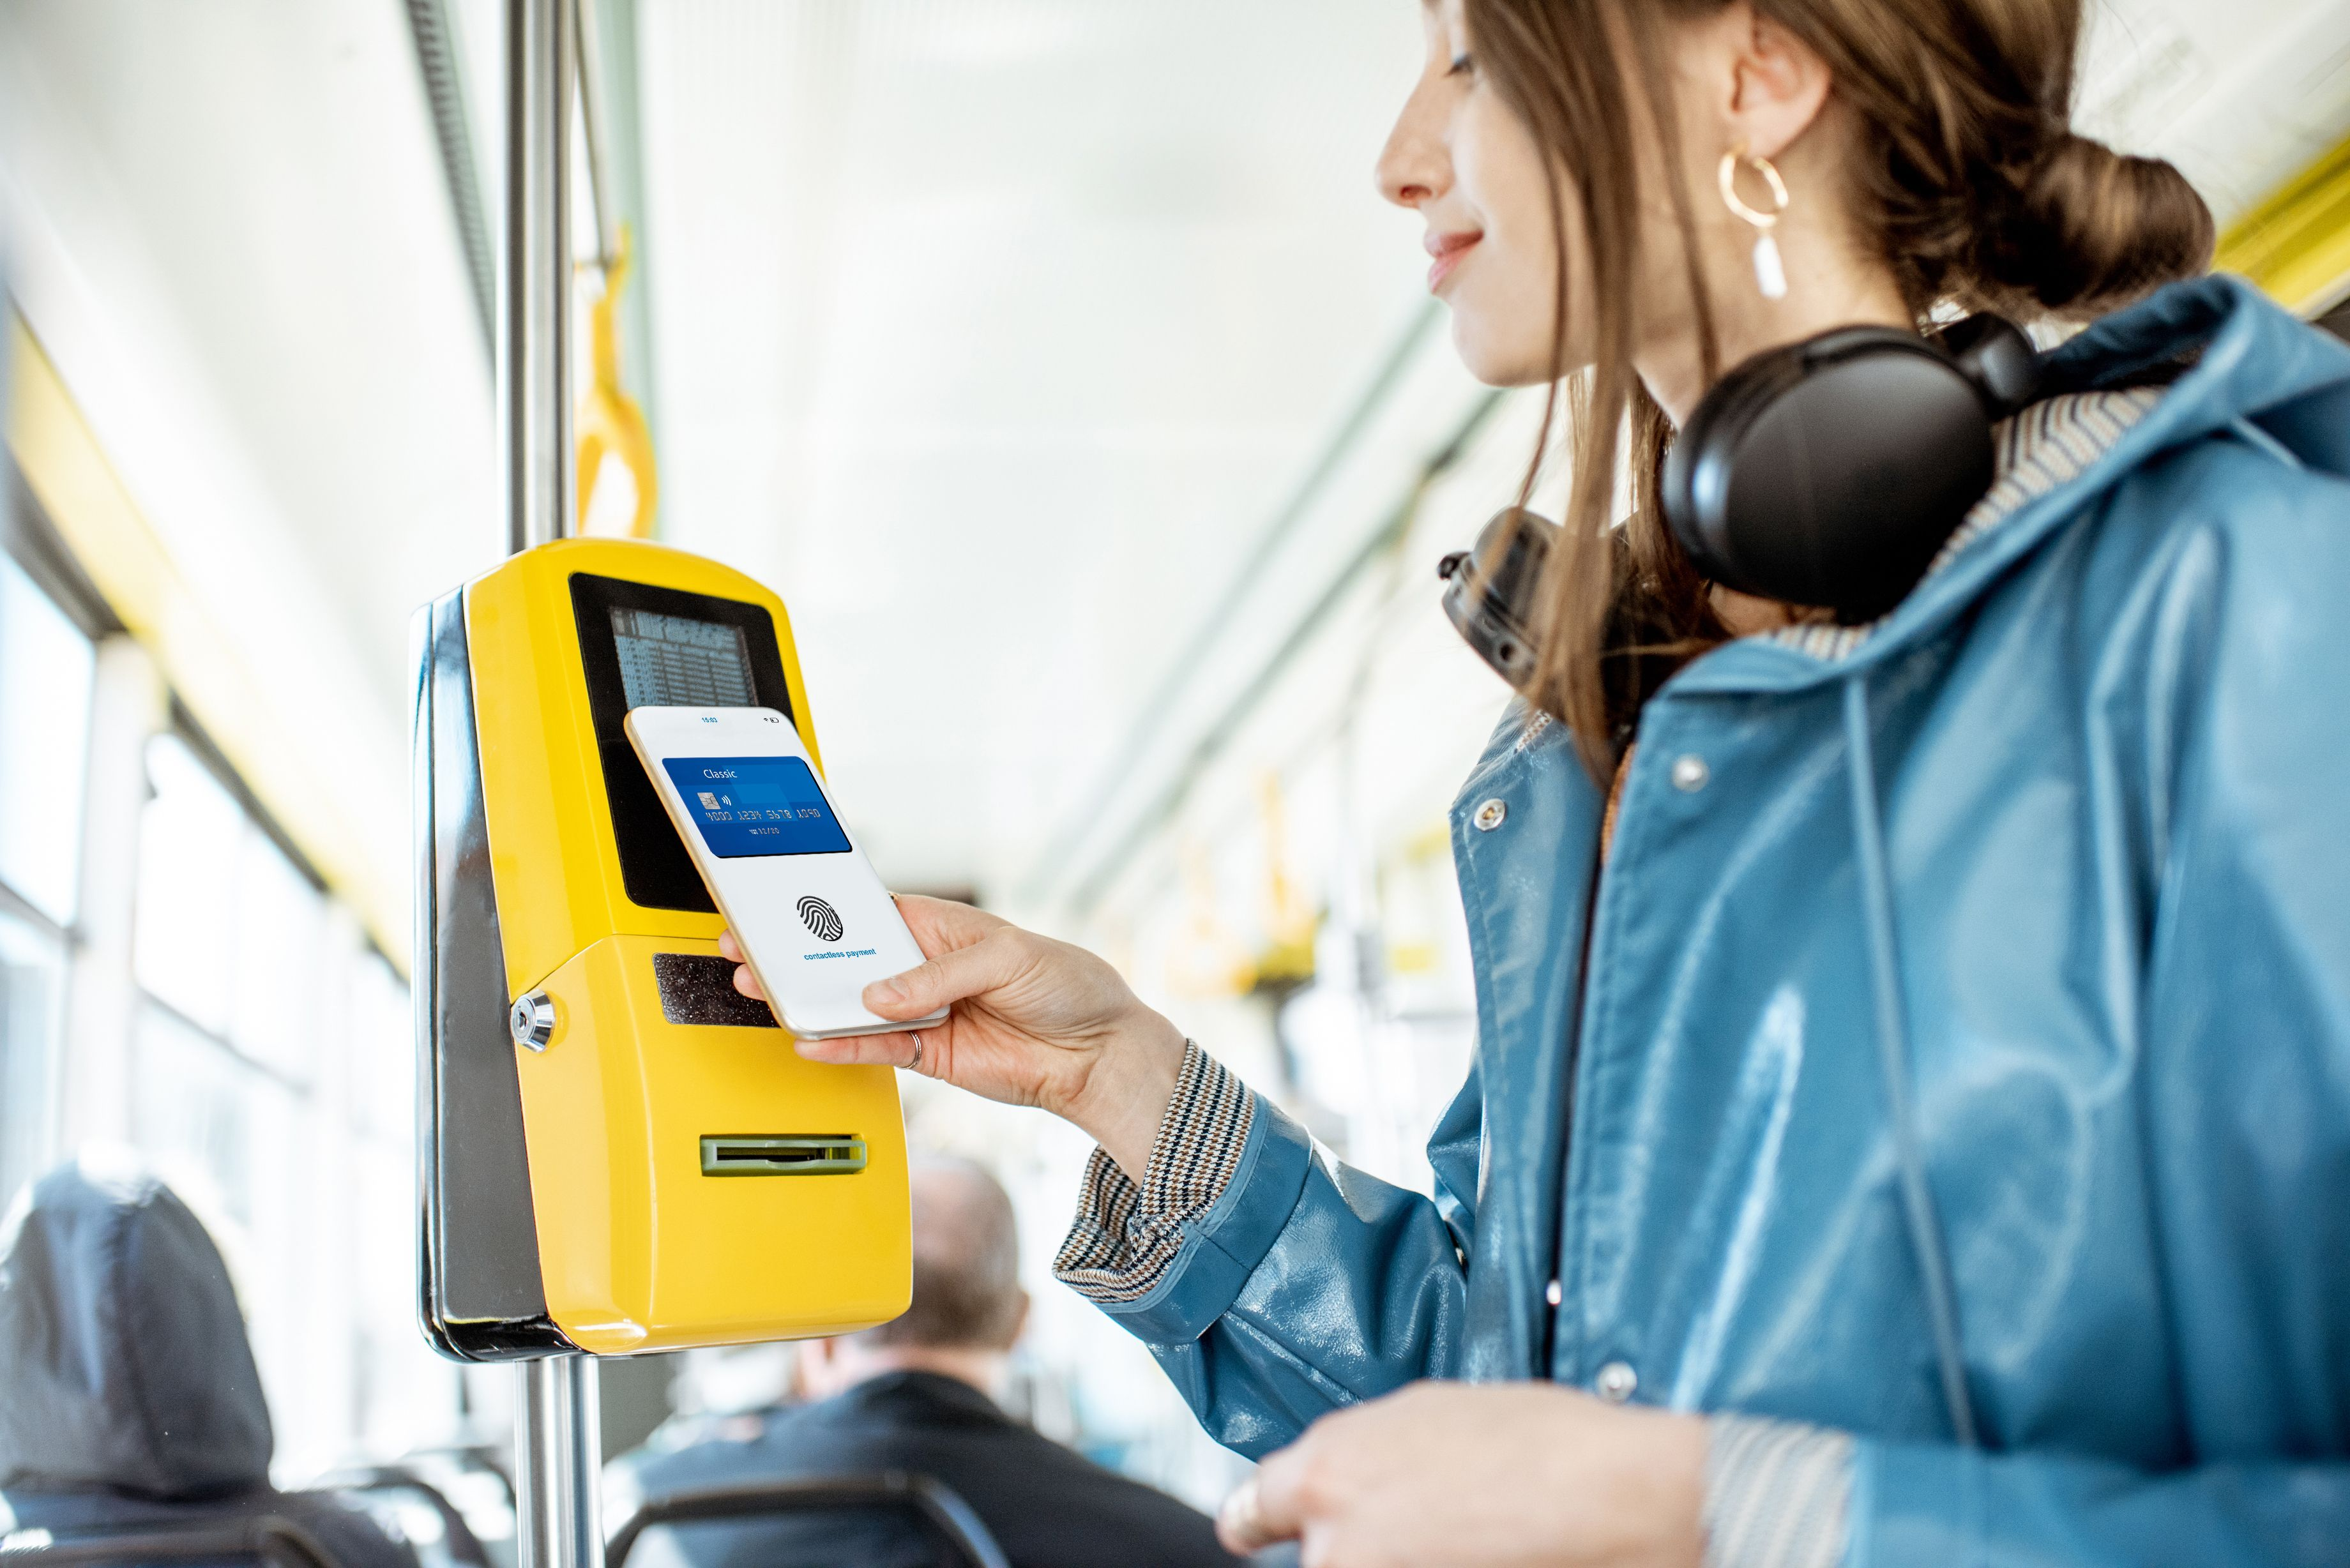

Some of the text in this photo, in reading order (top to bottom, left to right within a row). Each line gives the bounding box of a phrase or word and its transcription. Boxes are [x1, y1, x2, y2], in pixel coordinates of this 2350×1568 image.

[703, 769, 738, 778] Classic
[706, 808, 821, 821] 4000 1234 5678 1090
[804, 948, 876, 960] contactless payment
